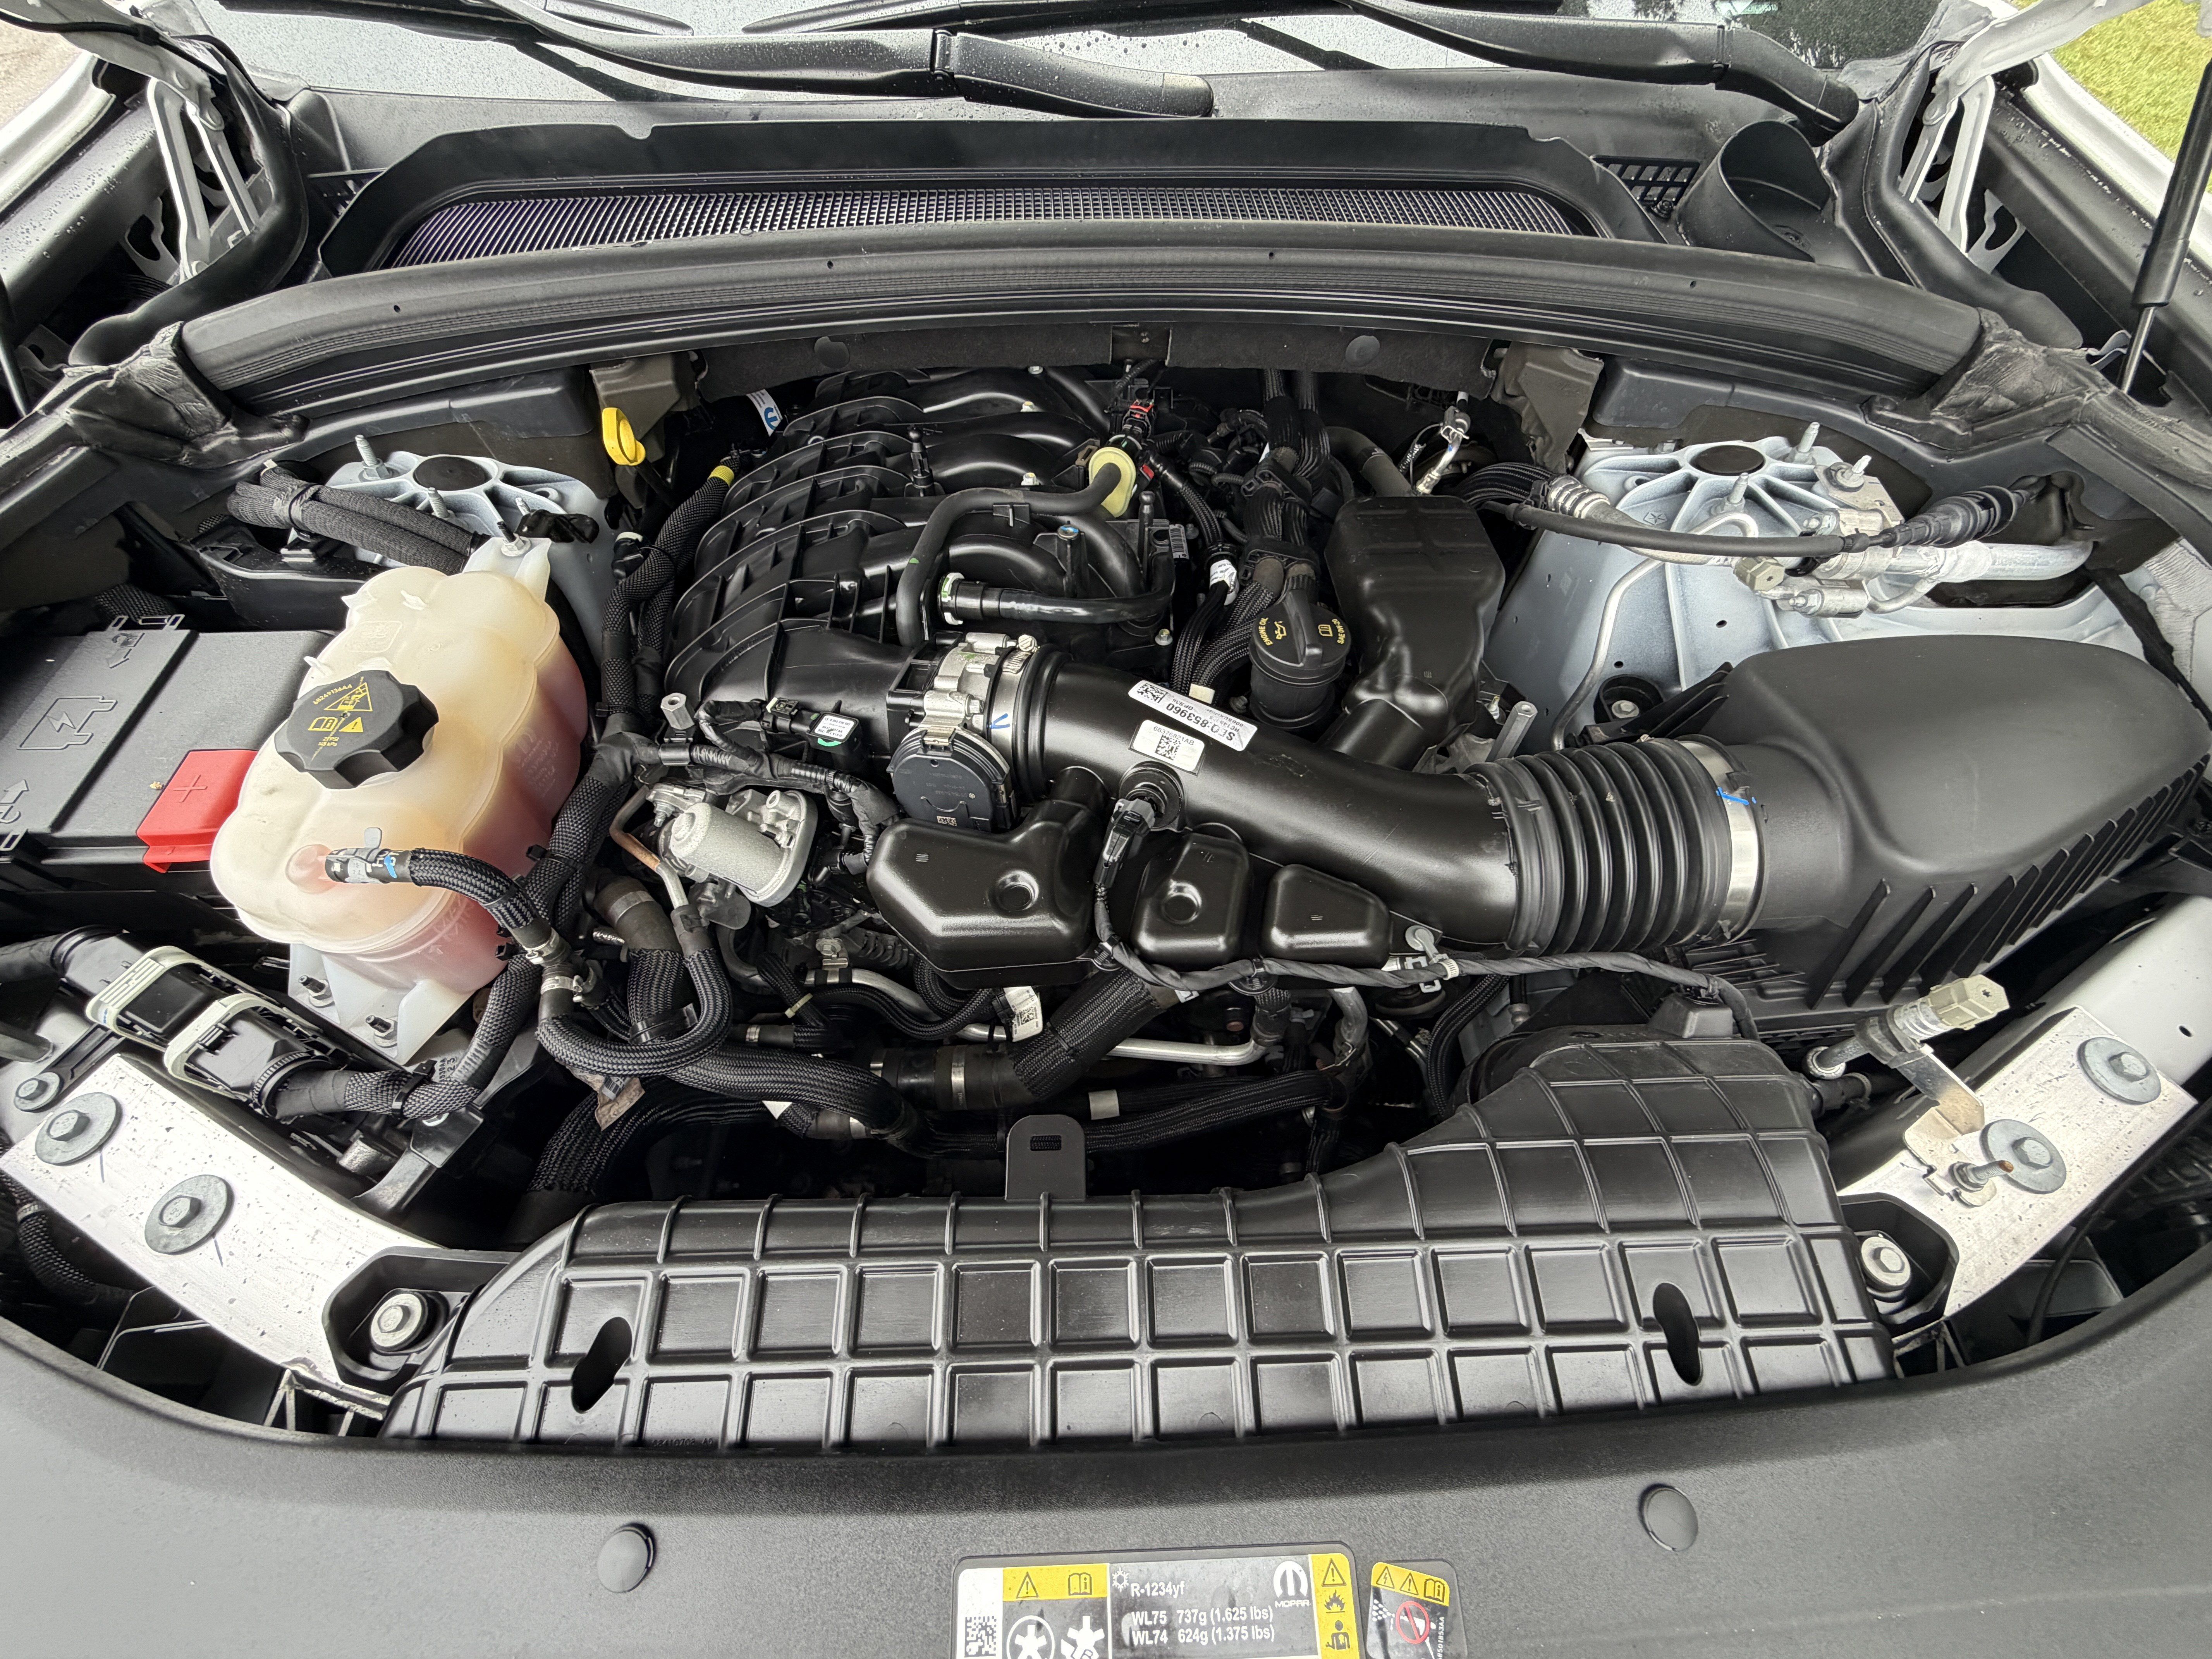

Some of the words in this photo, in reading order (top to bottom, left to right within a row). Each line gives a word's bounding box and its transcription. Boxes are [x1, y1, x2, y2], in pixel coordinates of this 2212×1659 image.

[1259, 617, 1268, 626] OIL
[1258, 626, 1273, 646] ENGINE
[1337, 633, 1345, 644] SAE
[1153, 725, 1195, 746] 68376821AB
[1131, 1581, 1185, 1599] R-1234yf
[1275, 1599, 1310, 1608] MOPAR
[1131, 1610, 1167, 1626] WL75
[1176, 1609, 1207, 1626] 737g
[1210, 1606, 1247, 1625] (1.625
[1250, 1605, 1274, 1623] lbs)
[1132, 1630, 1168, 1645] WL74
[1178, 1628, 1208, 1646] 624g
[1212, 1626, 1248, 1645] (1.375
[1252, 1624, 1275, 1642] lbs)
